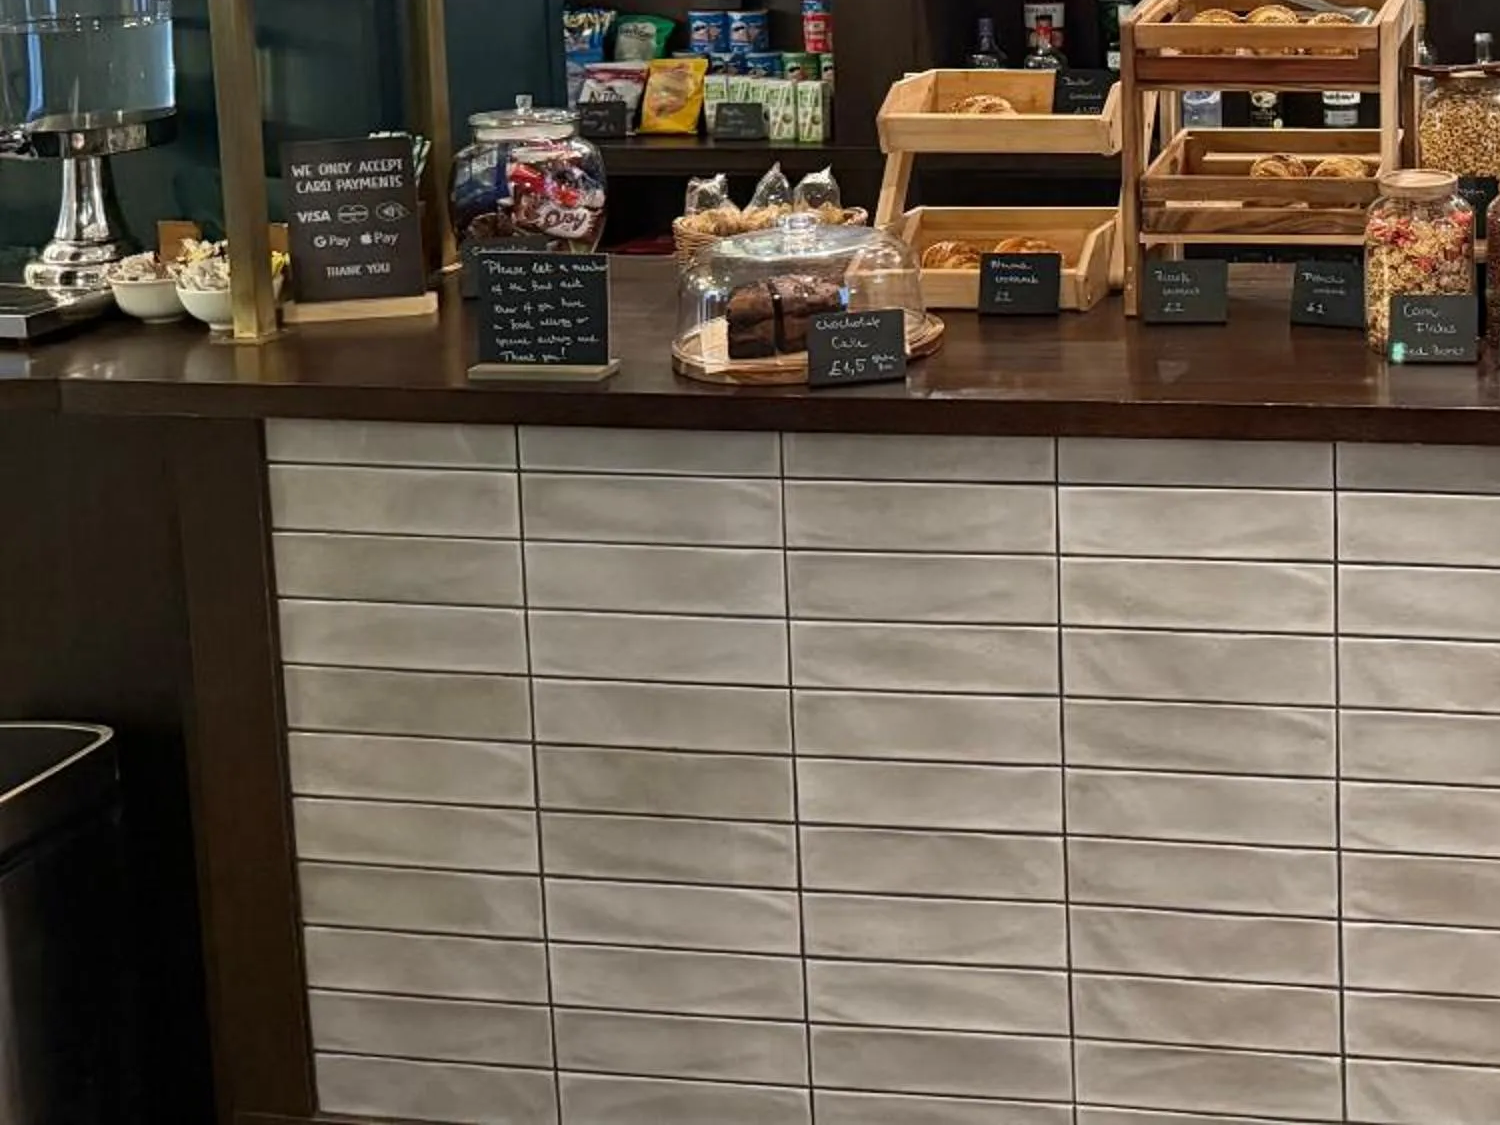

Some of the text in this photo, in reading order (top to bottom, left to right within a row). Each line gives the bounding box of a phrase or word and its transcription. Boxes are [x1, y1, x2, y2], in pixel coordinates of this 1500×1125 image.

[291, 158, 403, 177] WE ONLY ACCEPT
[295, 175, 403, 193] CARD PAYMENTS
[297, 210, 332, 223] VISA
[328, 235, 351, 248] Pay
[373, 232, 400, 246] Pay
[326, 262, 391, 278] THANK YOU
